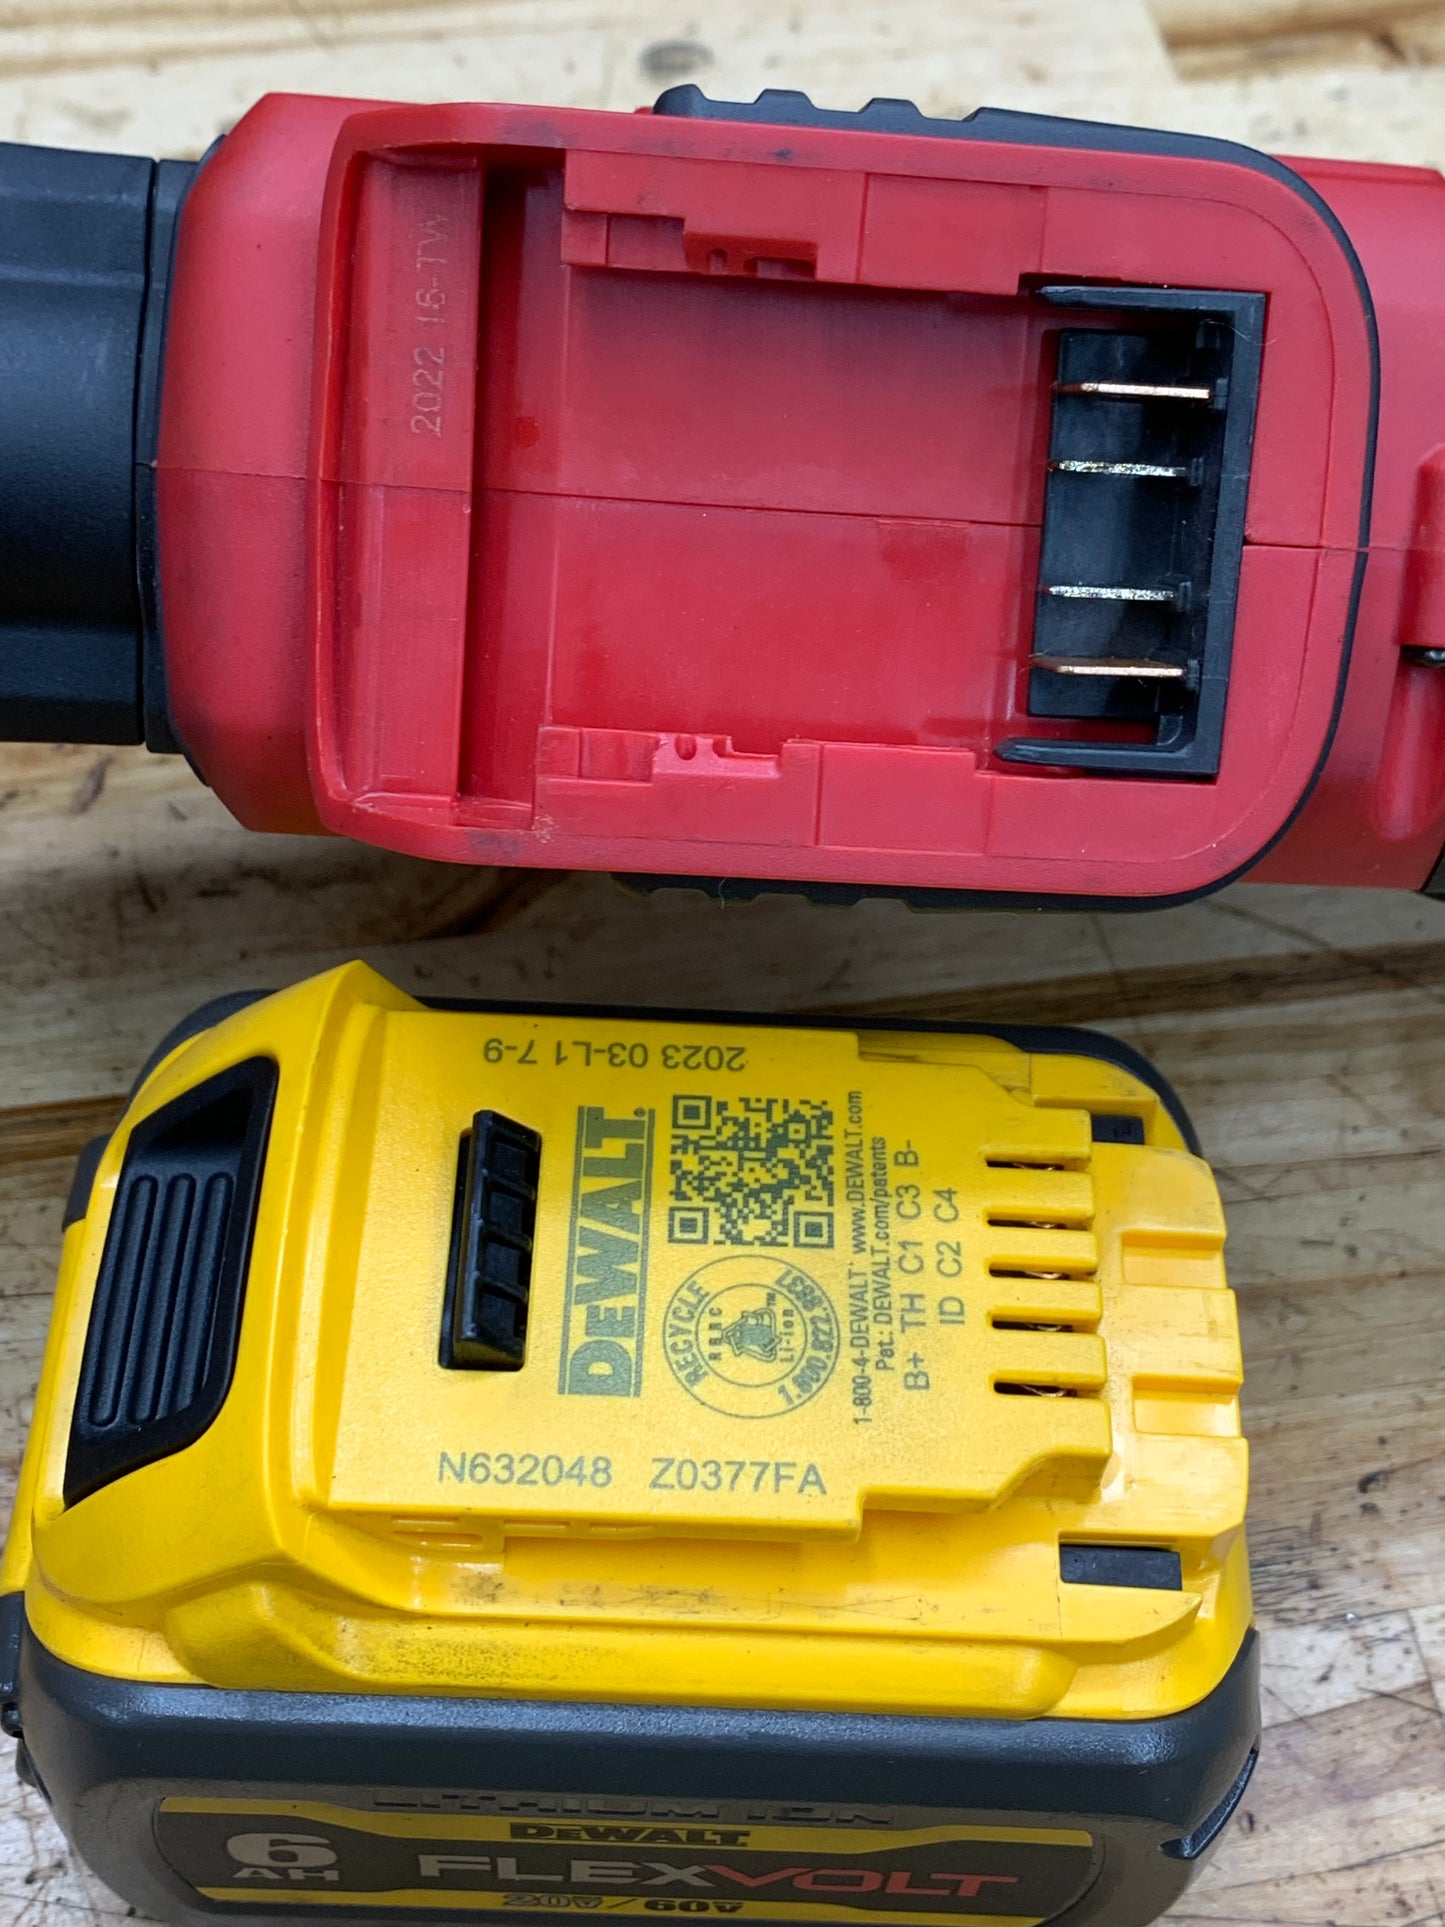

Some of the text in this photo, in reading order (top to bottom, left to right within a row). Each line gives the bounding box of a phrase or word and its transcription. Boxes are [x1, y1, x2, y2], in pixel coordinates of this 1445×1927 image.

[410, 346, 445, 438] 2022
[483, 1037, 747, 1072] 2023 03-L1 7-9
[844, 1090, 866, 1255] www.DEWALT.com
[566, 1105, 646, 1397] DEWALT
[869, 1136, 893, 1325] DEWALT.com/patents
[893, 1139, 930, 1391] B+ TH C1 C3 B-
[932, 1186, 966, 1325] ID C2 C4
[668, 1280, 710, 1388] RECYCLE
[779, 1308, 795, 1363] Li-ion
[437, 1451, 828, 1496] N632048 Z0377FA
[225, 1832, 339, 1868] 6
[510, 1822, 751, 1847] DEWALT
[231, 1866, 340, 1882] AH
[417, 1853, 1019, 1897] FLEXVOLT
